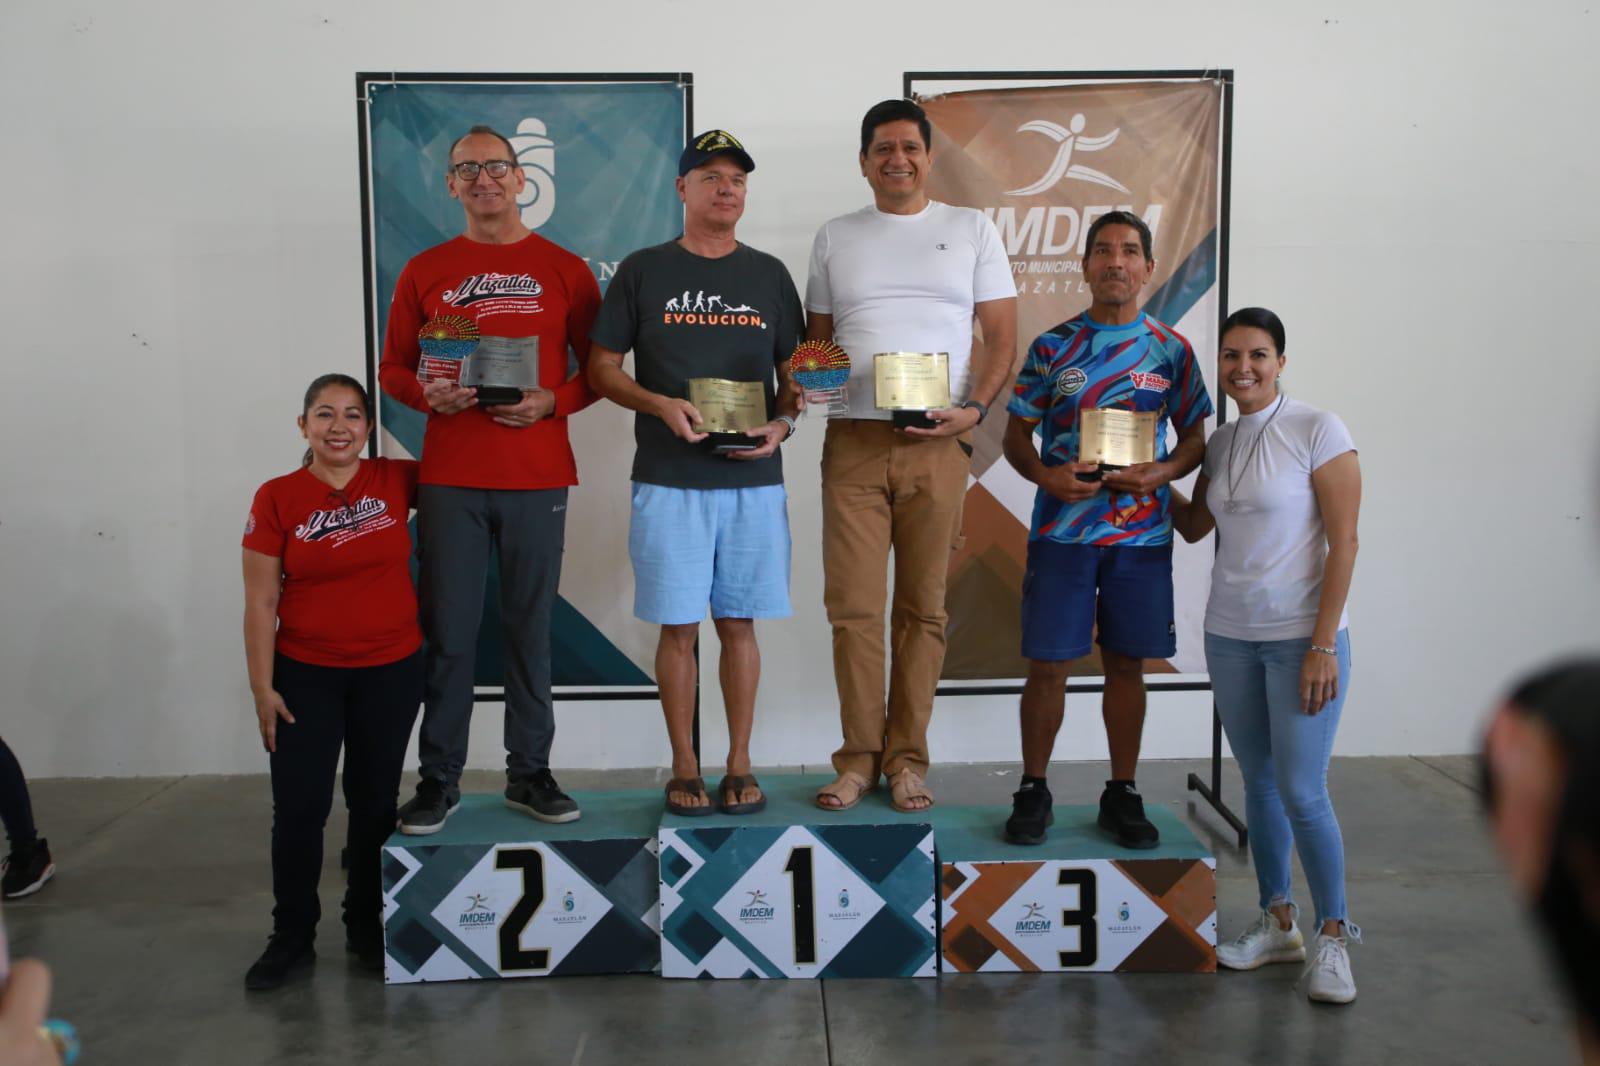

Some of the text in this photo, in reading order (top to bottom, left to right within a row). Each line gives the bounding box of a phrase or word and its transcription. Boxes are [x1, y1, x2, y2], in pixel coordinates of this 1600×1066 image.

[1027, 260, 1083, 274] MUNICIPAL
[442, 273, 541, 304] Mazatlán
[664, 313, 761, 327] EVOLUCION
[495, 849, 550, 971] 2
[782, 845, 816, 964] 1
[459, 911, 496, 924] IMDEM
[739, 907, 775, 918] IMDEM
[1058, 868, 1098, 968] 3
[1015, 920, 1052, 931] IMDEM
